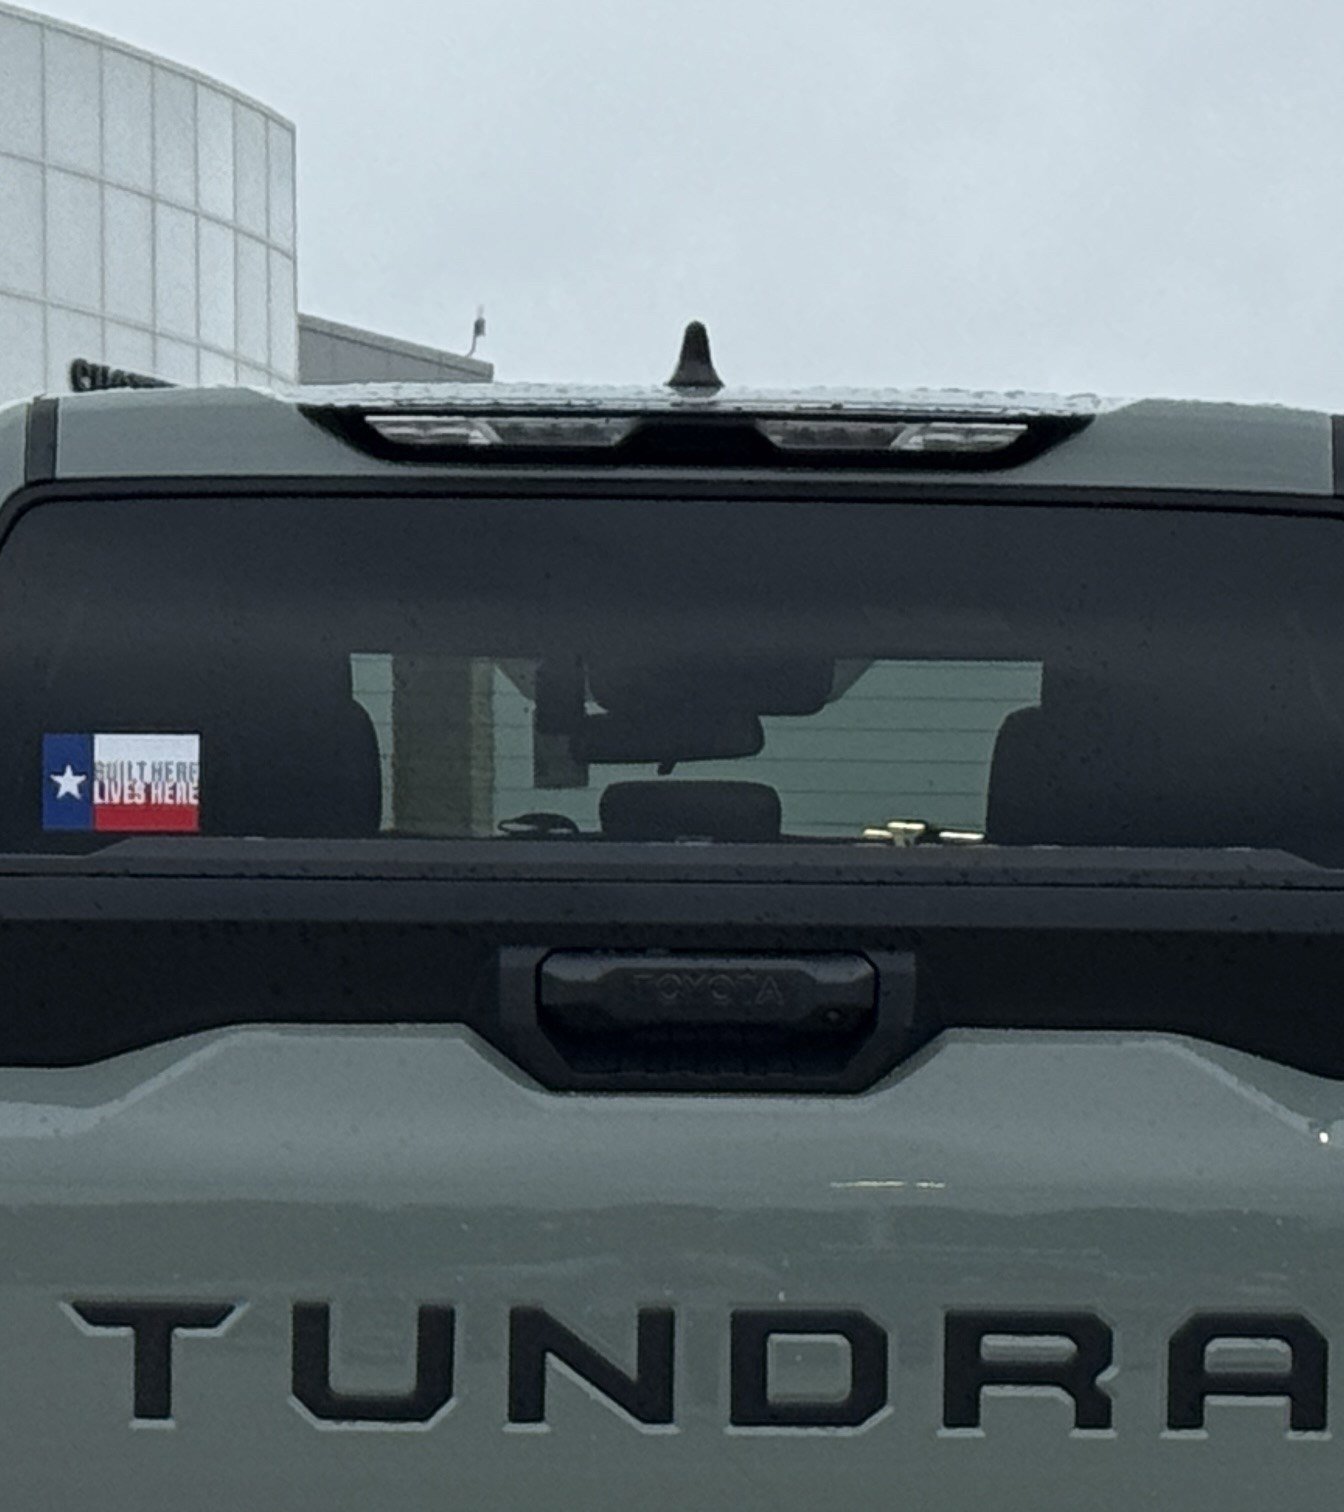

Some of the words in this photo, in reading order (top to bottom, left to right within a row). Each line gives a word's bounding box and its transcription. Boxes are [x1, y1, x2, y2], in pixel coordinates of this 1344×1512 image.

[95, 761, 147, 780] BUILT
[151, 761, 199, 782] HERE
[94, 780, 146, 804] LIVES
[151, 781, 199, 804] HERE
[633, 973, 785, 1006] TOYOTA
[65, 1300, 1331, 1438] TUNDRA
